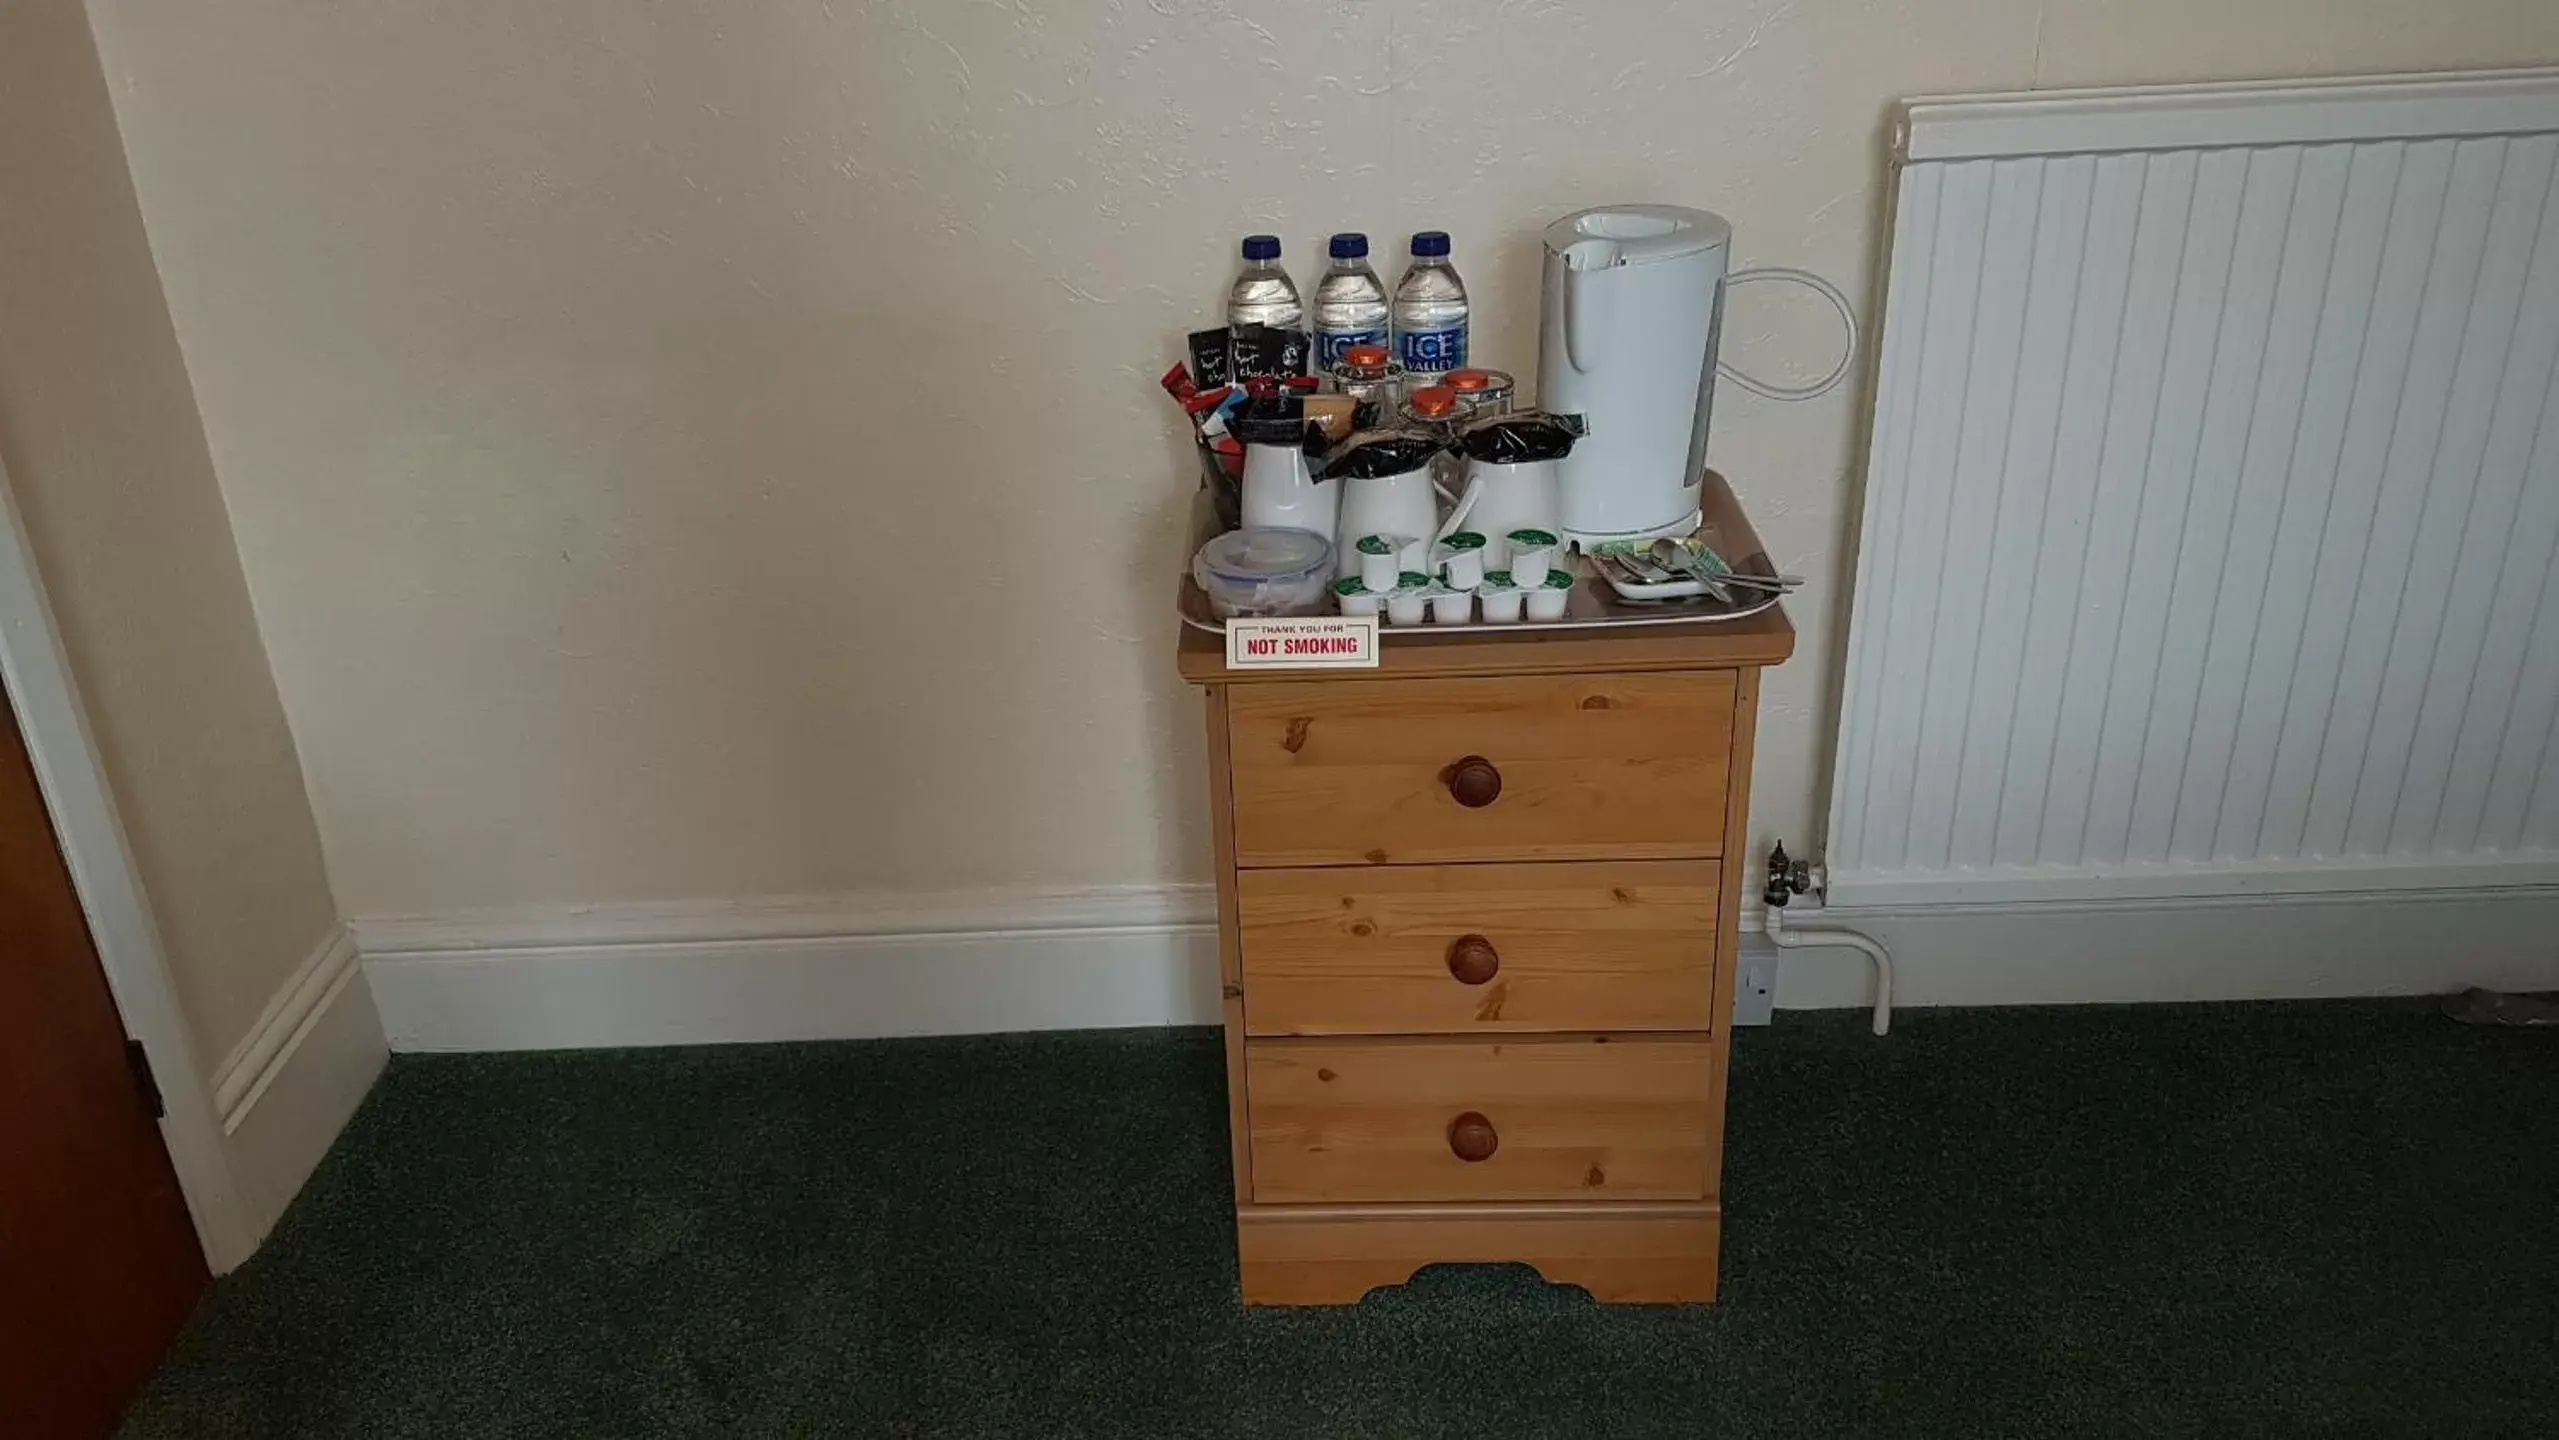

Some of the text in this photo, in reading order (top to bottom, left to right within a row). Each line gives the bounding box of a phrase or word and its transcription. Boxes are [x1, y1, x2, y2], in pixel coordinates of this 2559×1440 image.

[1406, 333, 1453, 359] ICE
[1406, 359, 1454, 372] VALLEY
[1261, 624, 1344, 634] THANK YOU FOR
[1247, 637, 1358, 655] NOT SMOKING
